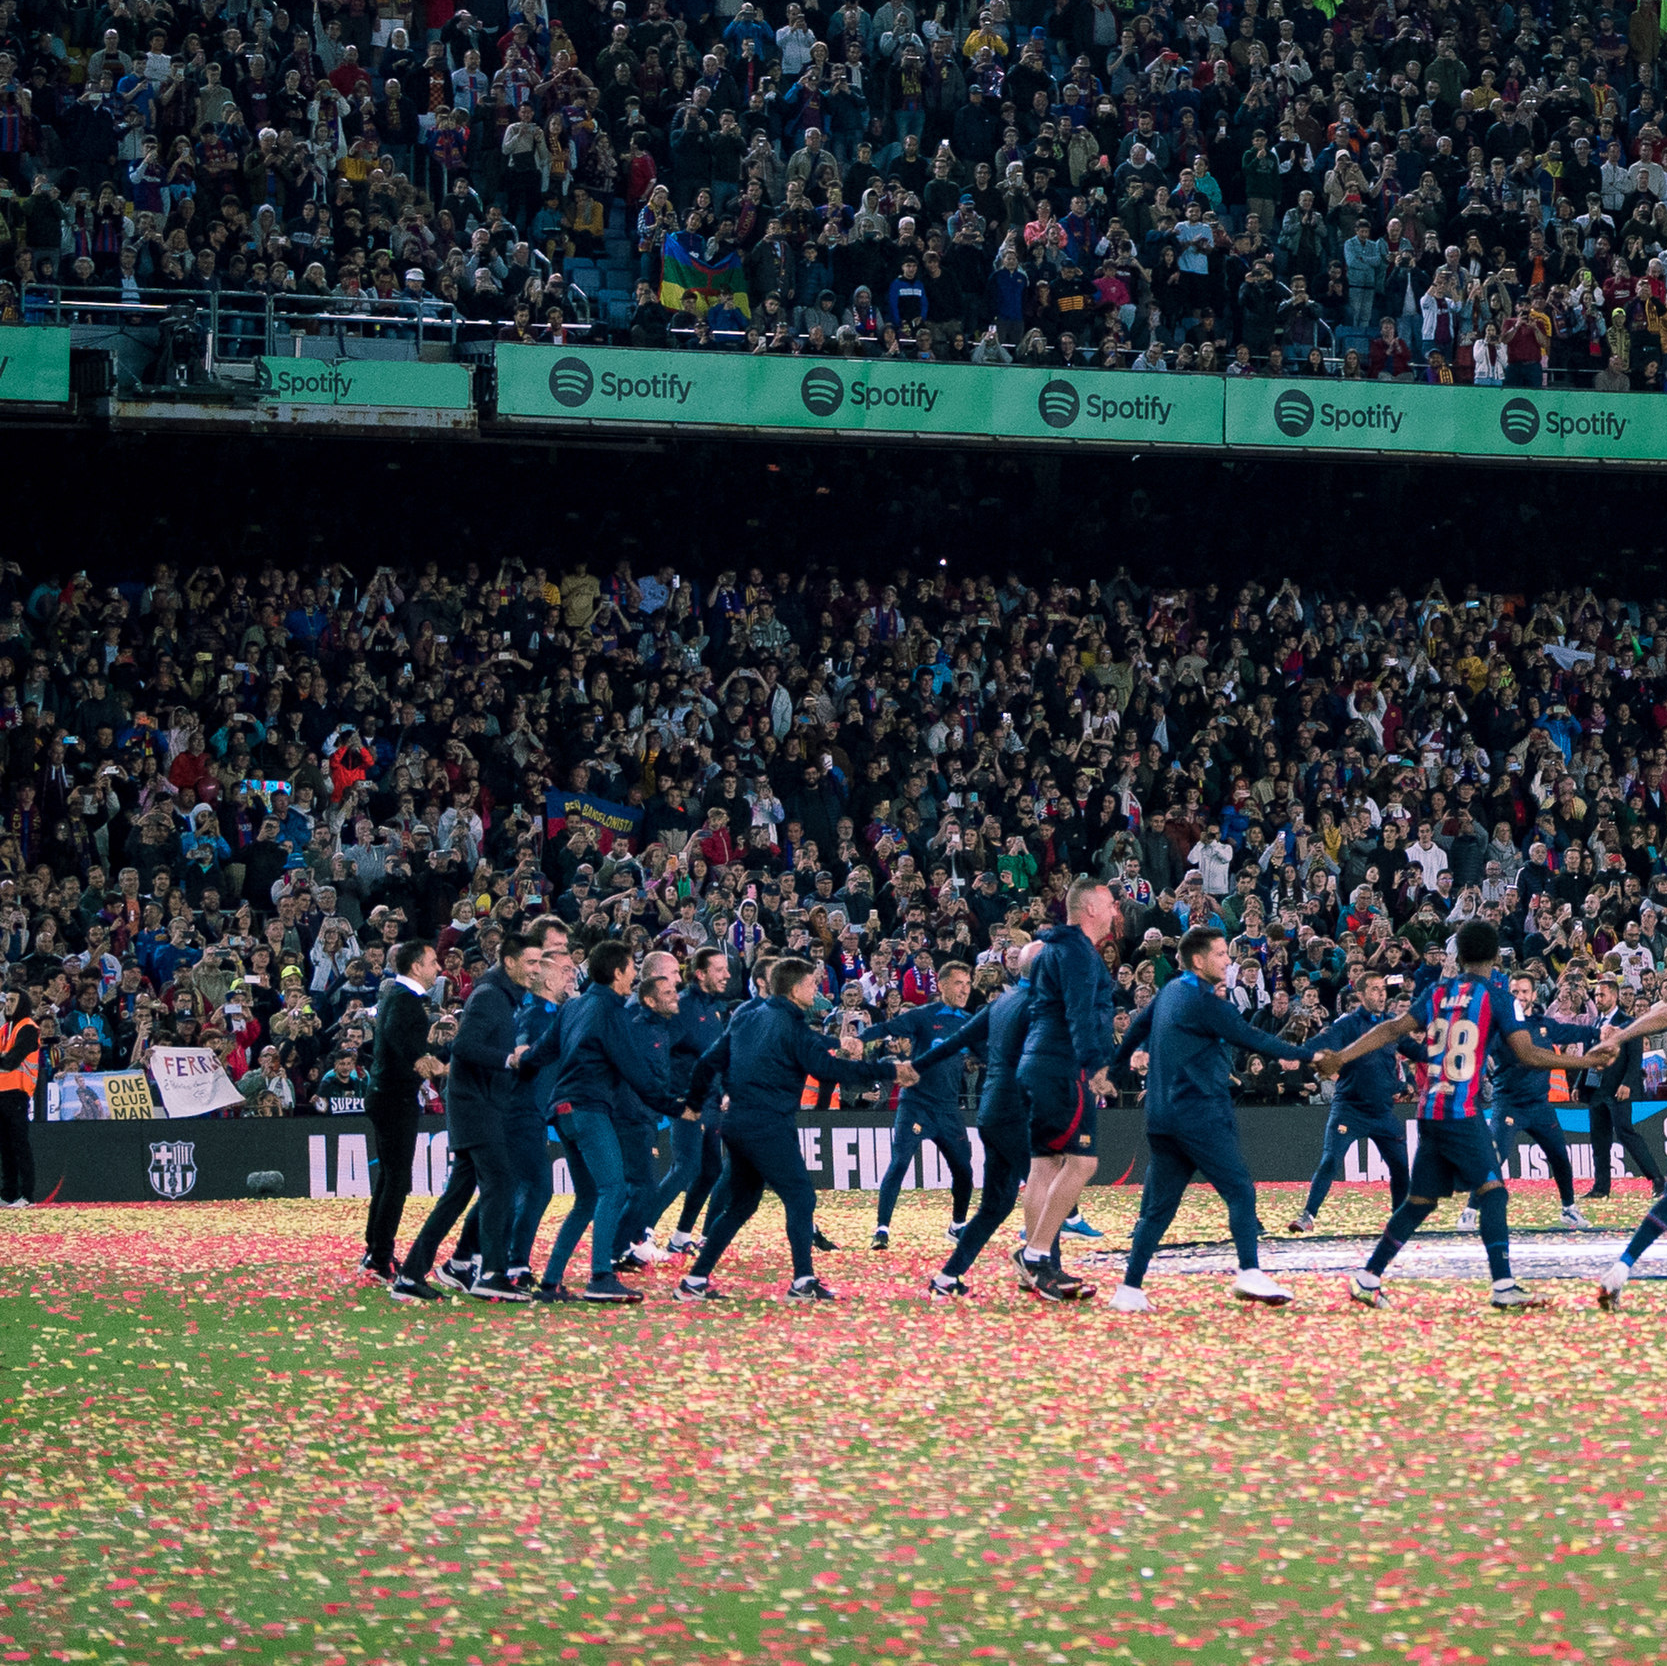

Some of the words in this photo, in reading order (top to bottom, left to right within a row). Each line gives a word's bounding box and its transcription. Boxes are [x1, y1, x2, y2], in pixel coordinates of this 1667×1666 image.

[277, 371, 353, 398] Spotify
[600, 371, 693, 404] Spotify
[850, 380, 939, 412] Spotify
[1086, 394, 1172, 425] Spotify
[1321, 403, 1403, 433] Spotify
[1546, 411, 1627, 440] Spotify
[1427, 1018, 1480, 1082] 28
[108, 1078, 146, 1094] ONE
[111, 1094, 148, 1108] CLUB
[113, 1106, 152, 1120] MAN
[308, 1133, 371, 1199] LA
[1518, 1143, 1550, 1179] IS
